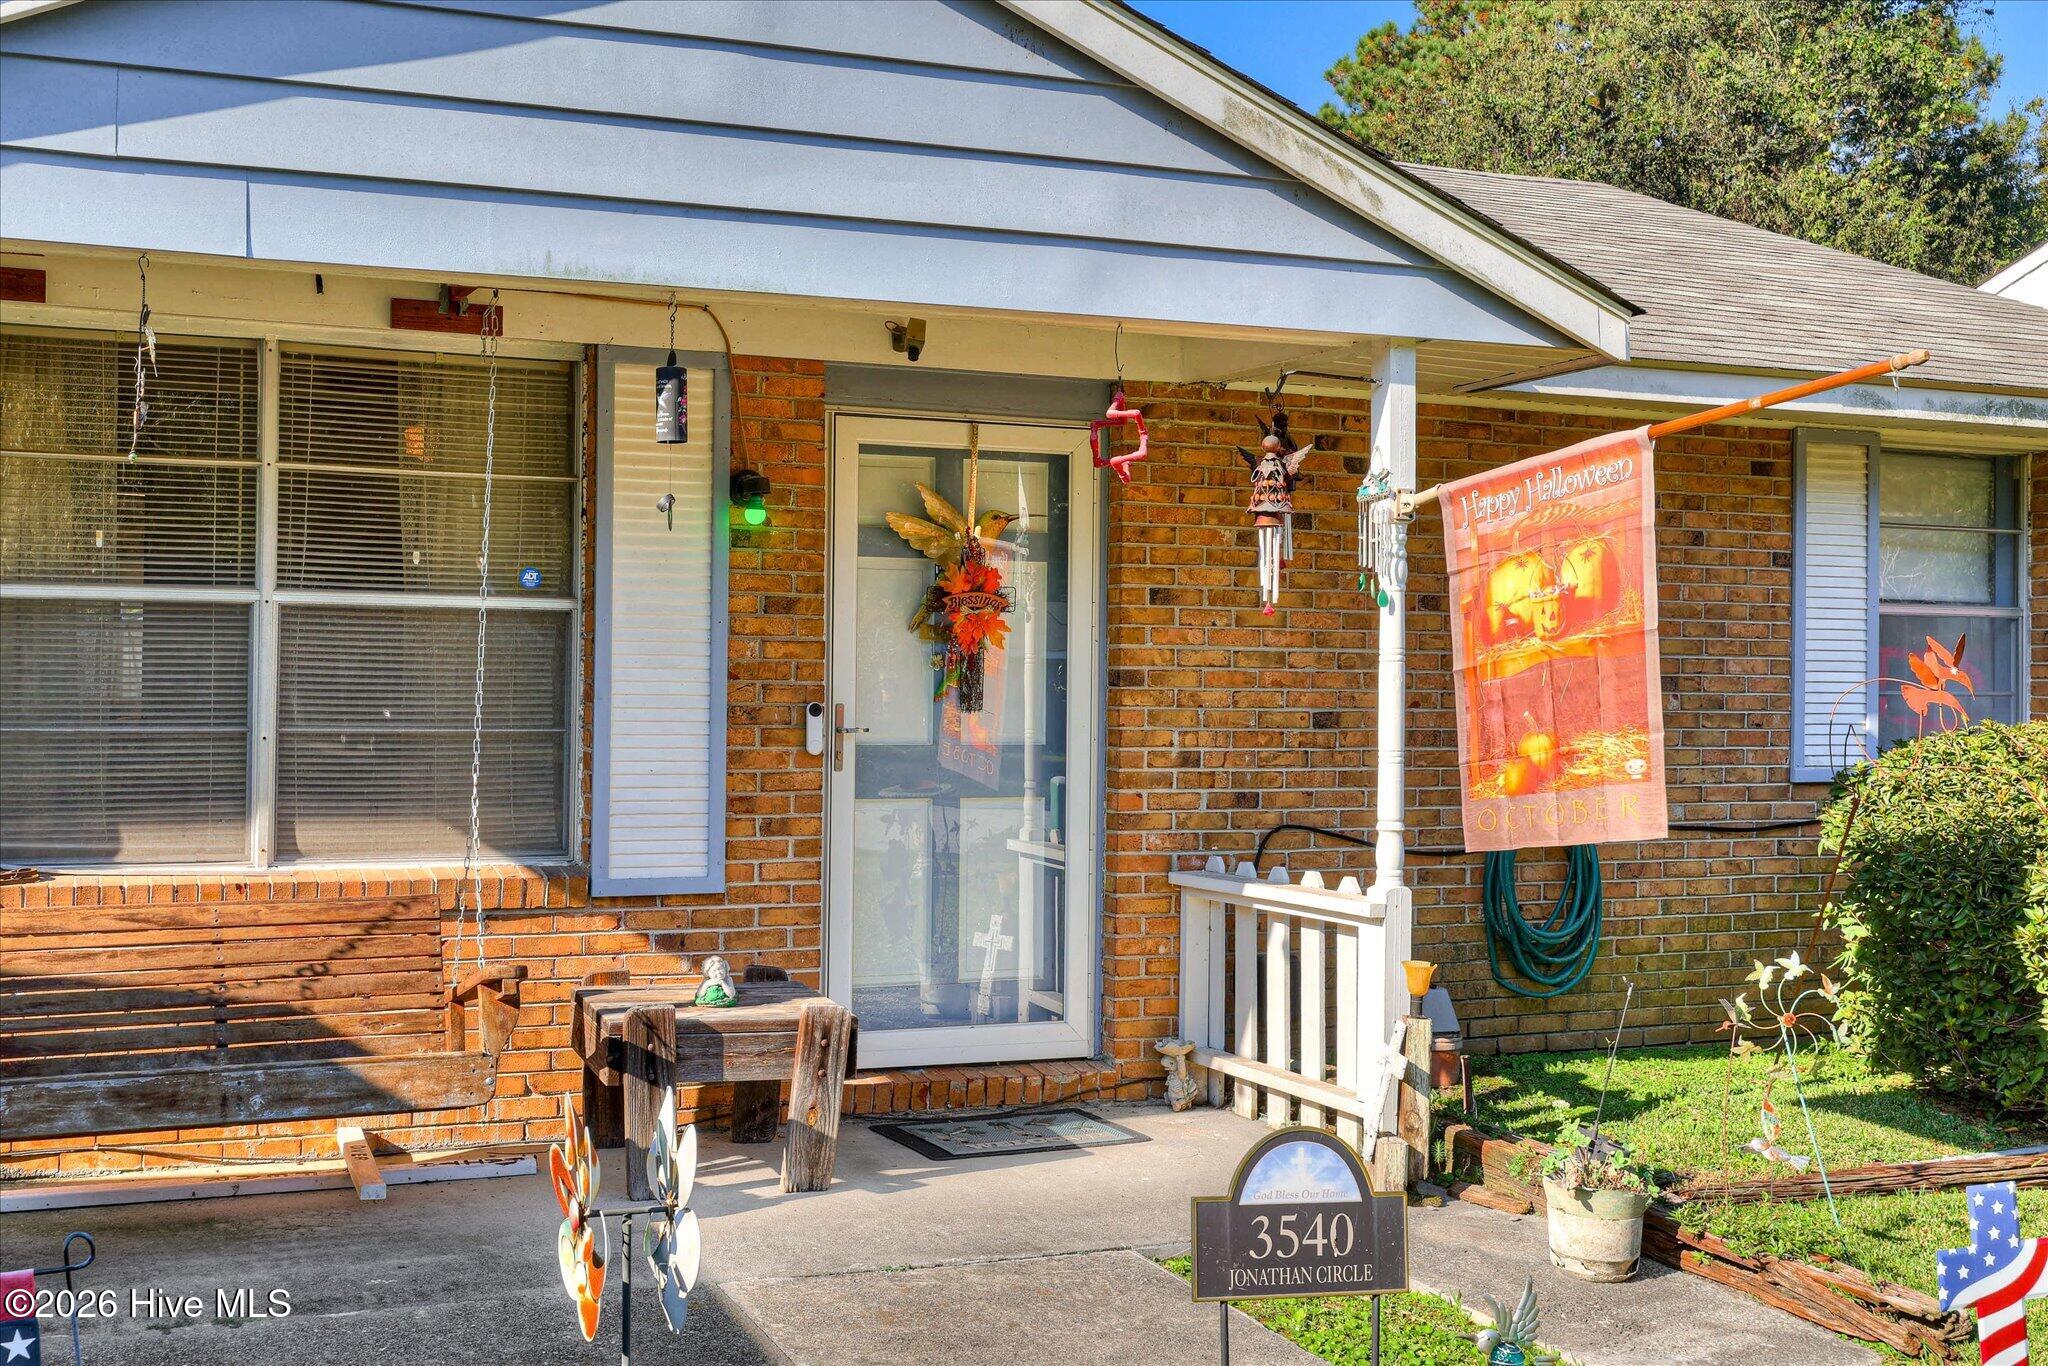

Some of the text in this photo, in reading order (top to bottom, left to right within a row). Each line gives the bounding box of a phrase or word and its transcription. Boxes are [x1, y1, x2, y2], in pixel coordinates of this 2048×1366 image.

[1460, 457, 1633, 529] Happy Halloween
[523, 572, 539, 580] ADT
[948, 595, 1003, 610] Blessings
[1477, 794, 1641, 831] OCTOBER
[1253, 1188, 1349, 1200] God Bless Our Home
[1249, 1213, 1354, 1259] 3540
[1228, 1264, 1374, 1291] JONATHAN CIRCLE
